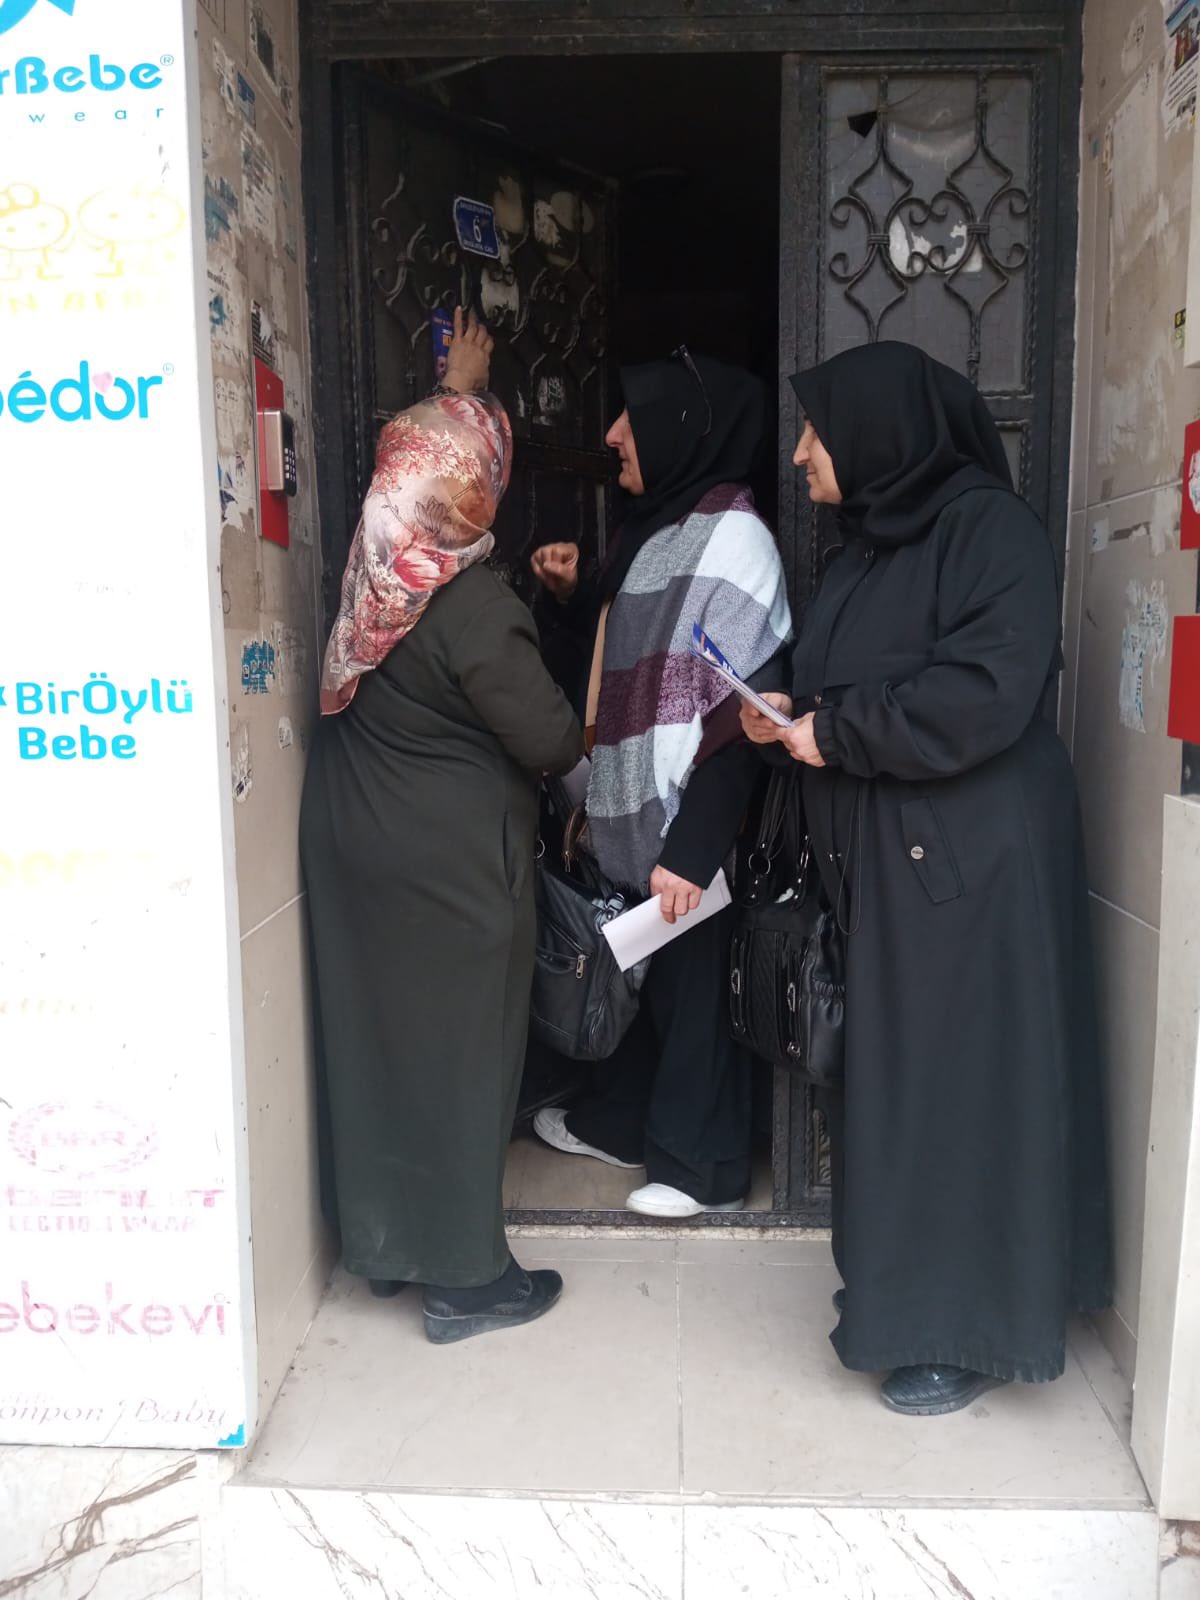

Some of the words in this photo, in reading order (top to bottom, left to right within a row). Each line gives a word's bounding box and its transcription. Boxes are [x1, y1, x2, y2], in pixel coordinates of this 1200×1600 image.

[472, 215, 482, 243] 6
[0, 360, 163, 423] édor
[16, 672, 193, 724] BirÖylü
[18, 724, 137, 760] Bebe
